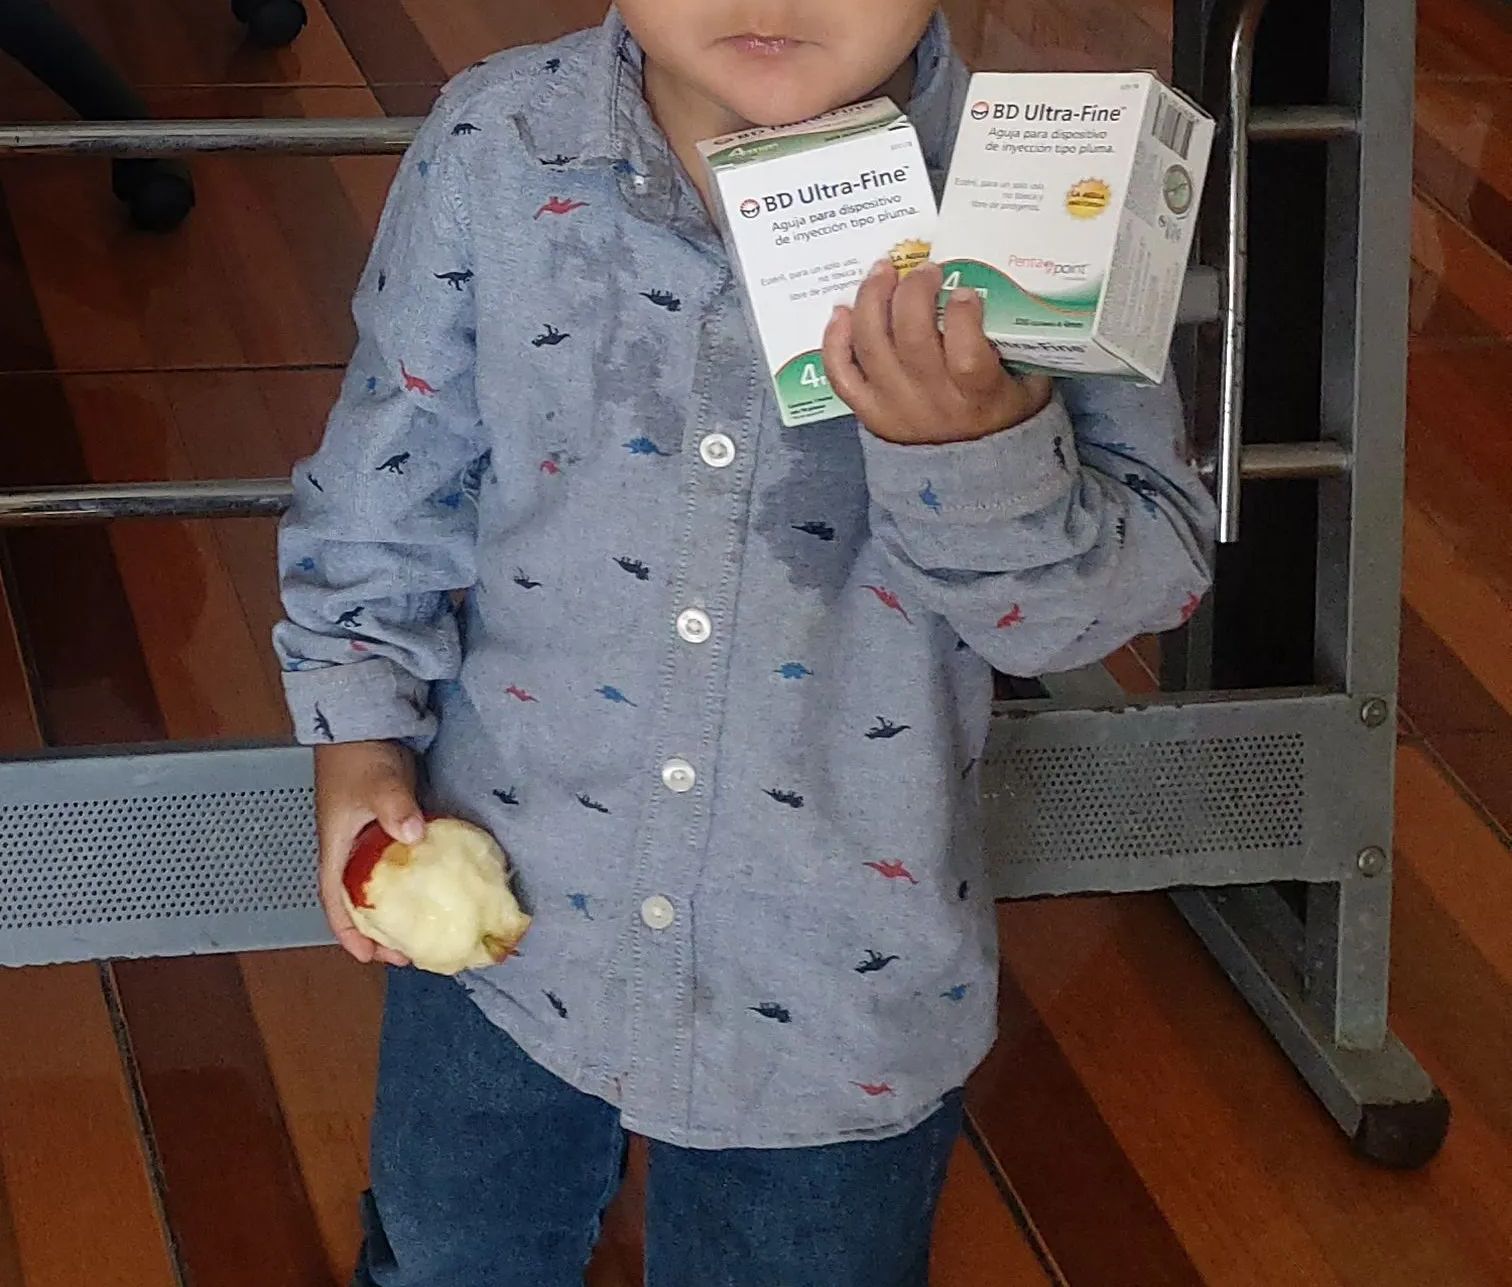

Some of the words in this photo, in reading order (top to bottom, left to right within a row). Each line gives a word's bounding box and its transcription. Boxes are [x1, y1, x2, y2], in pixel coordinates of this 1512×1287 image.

[992, 103, 1019, 120] BD
[988, 127, 1020, 140] Aguja
[1023, 130, 1048, 140] para
[1051, 128, 1108, 140] dispositivo
[985, 142, 999, 152] de
[1055, 143, 1076, 154] tipo
[762, 192, 794, 213] BD
[771, 215, 807, 233] Aguja
[809, 209, 838, 225] para
[838, 193, 902, 217] dispositivo
[775, 232, 791, 246] de
[792, 220, 848, 243] inyección
[851, 214, 875, 230] tipo
[878, 204, 919, 224] pluma.
